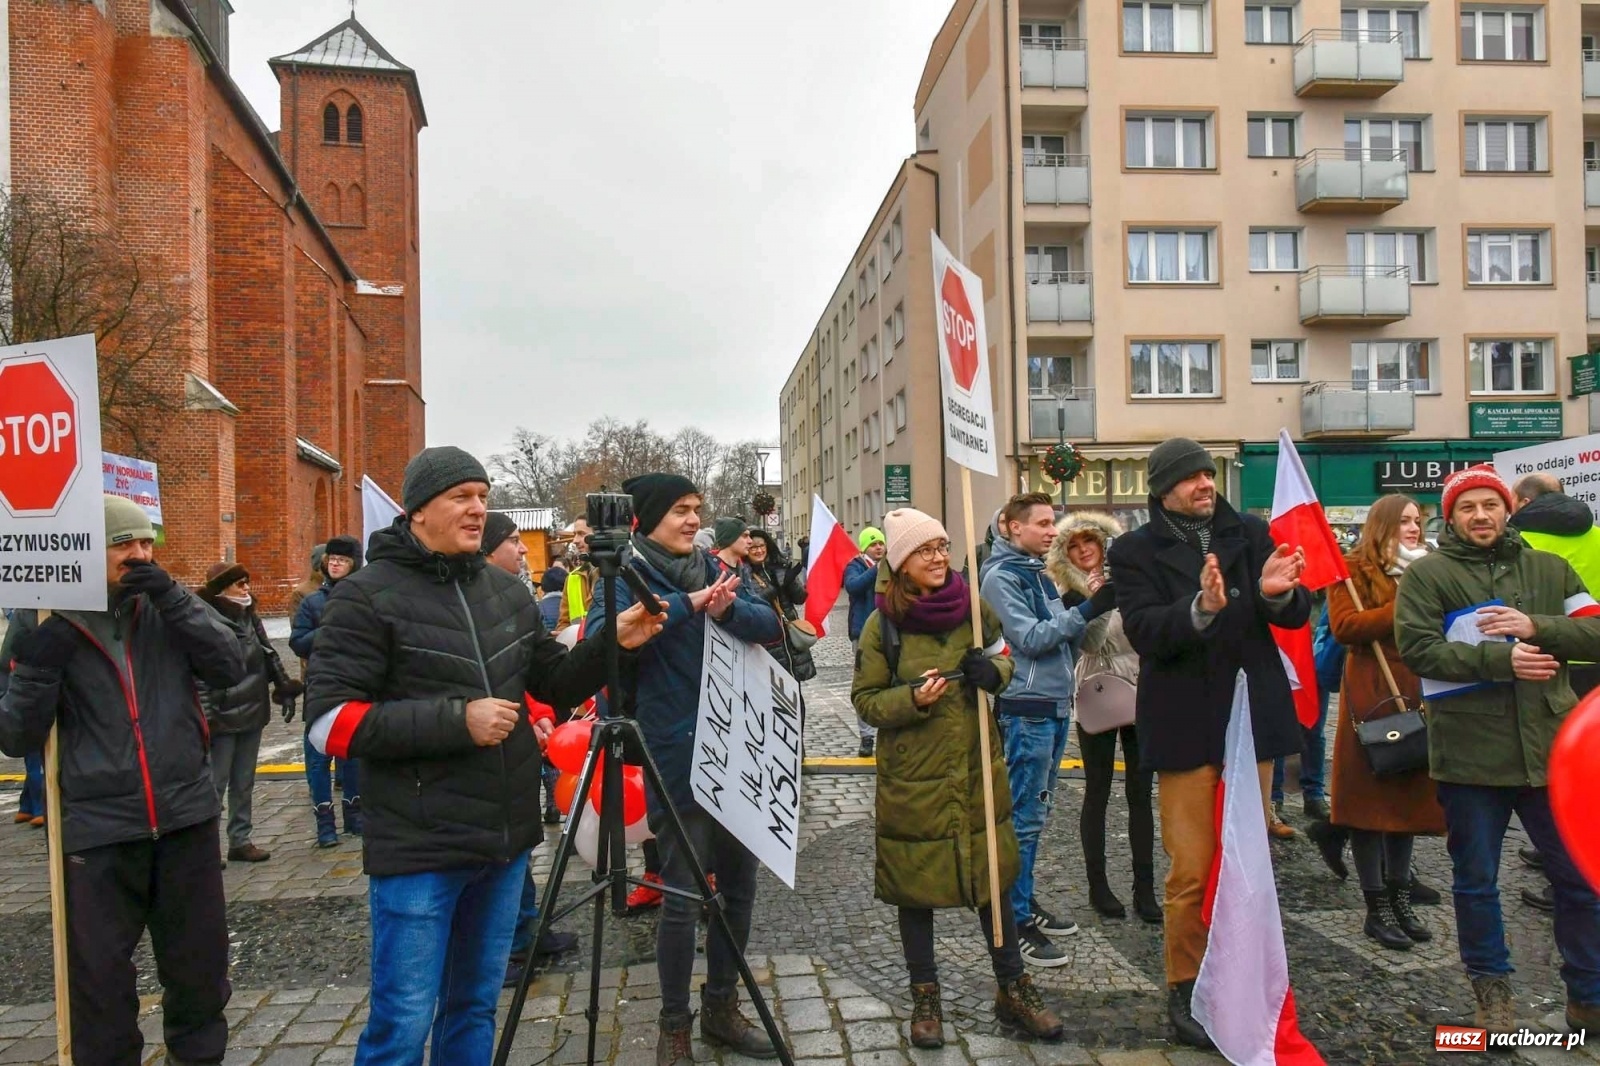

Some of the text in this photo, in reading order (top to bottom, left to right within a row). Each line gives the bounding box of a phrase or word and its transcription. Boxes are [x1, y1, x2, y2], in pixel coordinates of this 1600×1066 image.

[942, 299, 975, 351] STOP
[947, 396, 987, 431] SEGREGACJI
[949, 422, 989, 454] SANITARNEJ
[116, 464, 154, 482] NORMALNIE
[1515, 463, 1534, 475] Kto
[1537, 455, 1575, 470] oddaje
[1412, 481, 1437, 489] 1989
[0, 533, 91, 552] ZYMUSOWI
[0, 560, 82, 583] ZCZEPIEŃ
[710, 624, 732, 671] TV
[765, 665, 799, 850] MYŚLENIE
